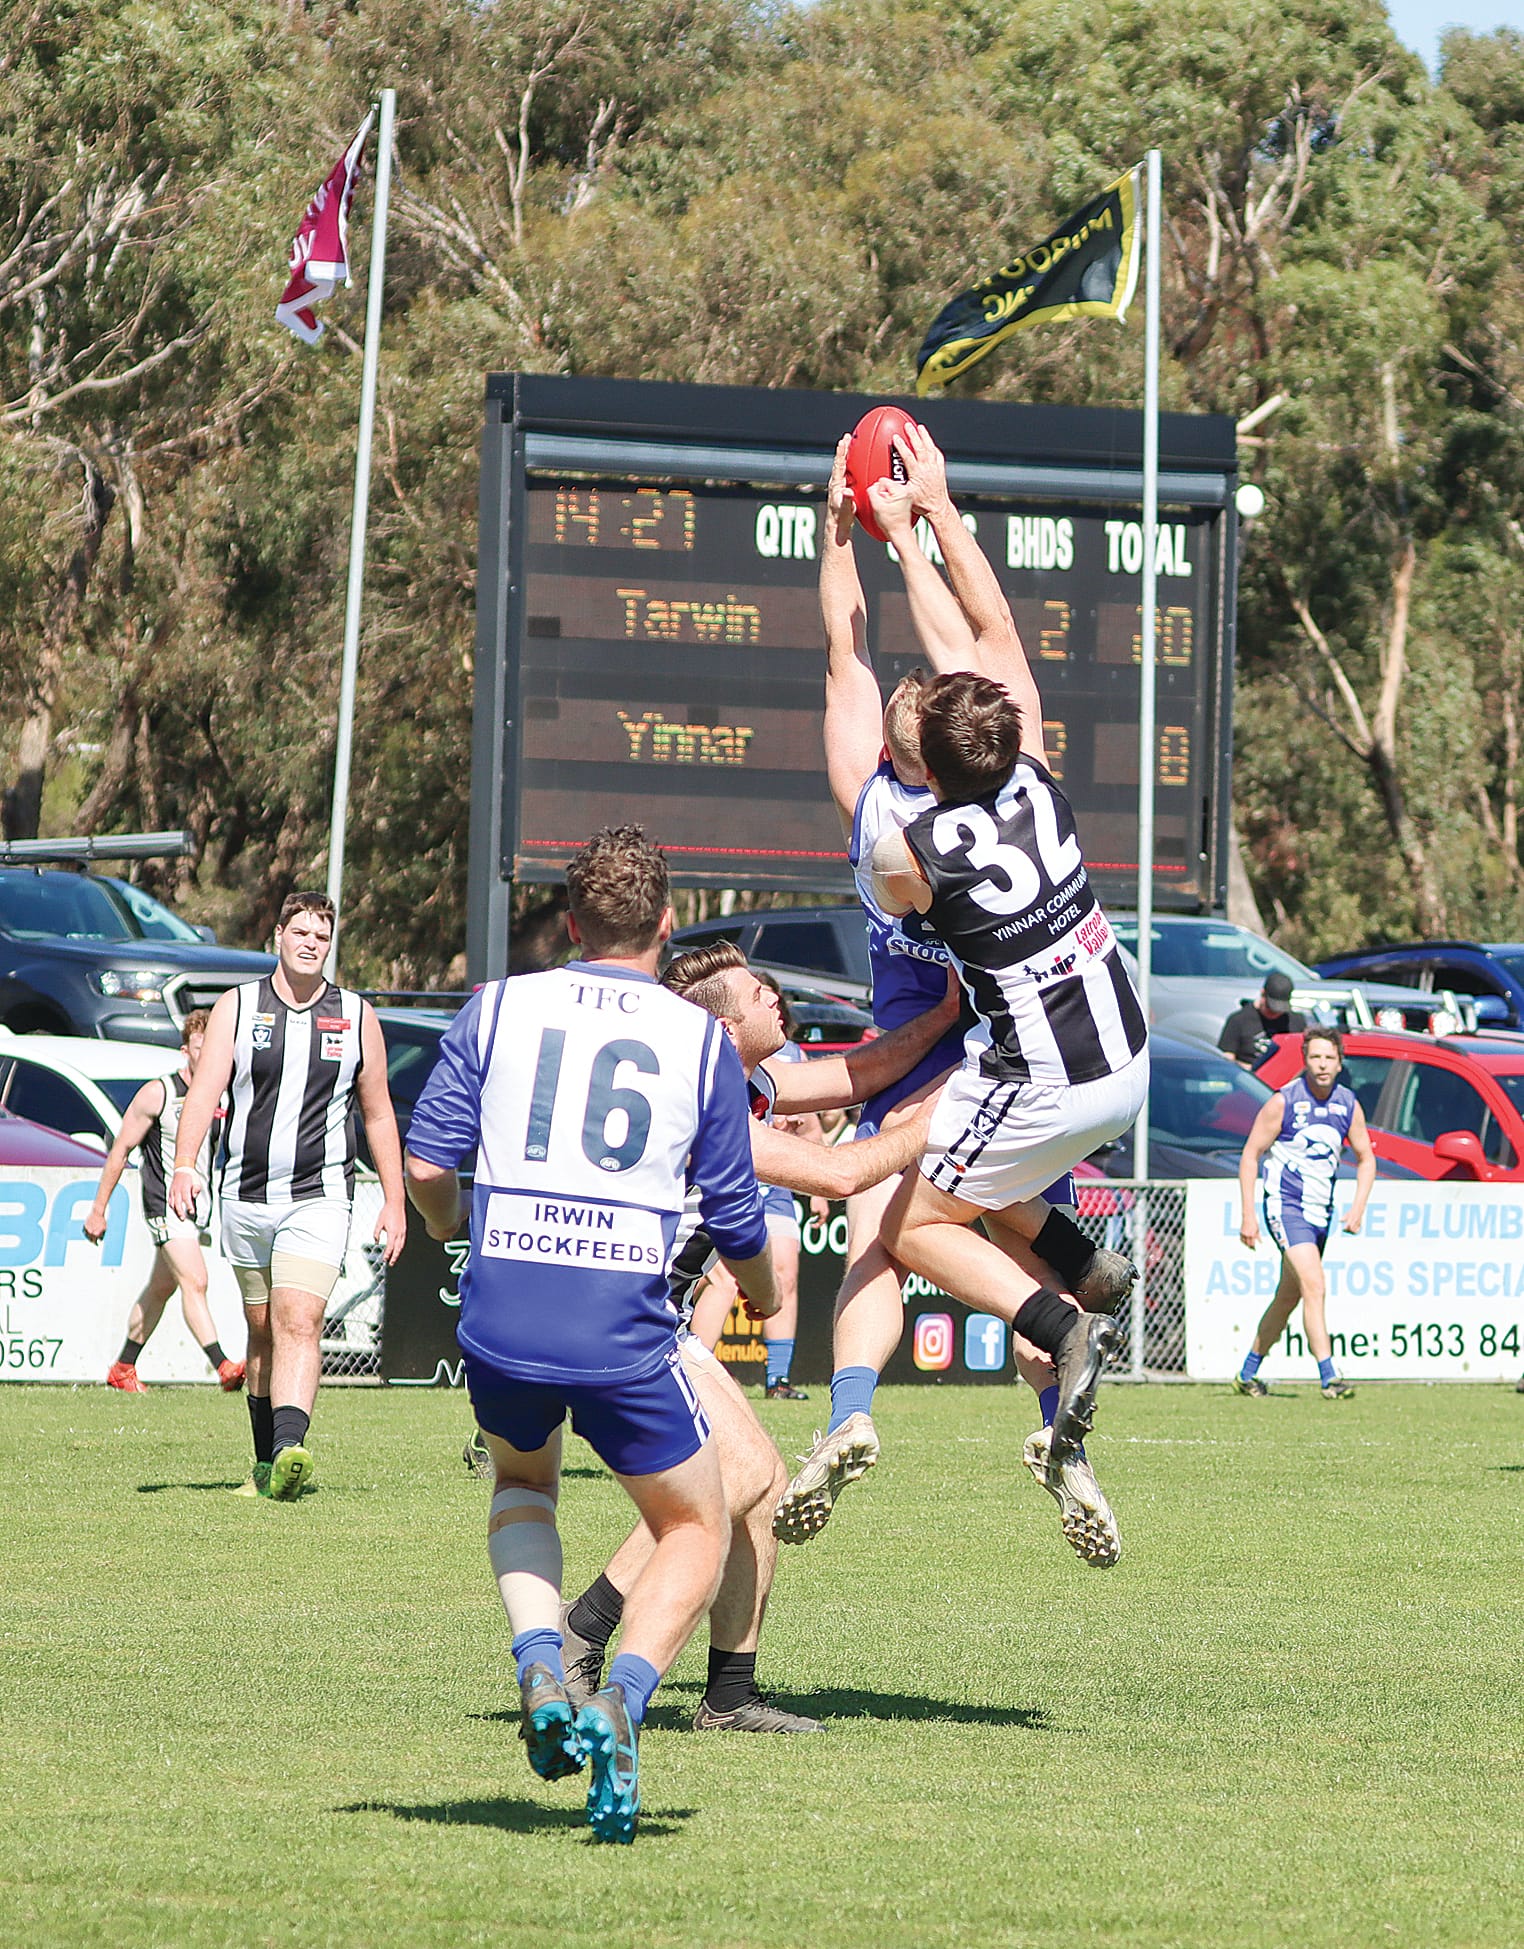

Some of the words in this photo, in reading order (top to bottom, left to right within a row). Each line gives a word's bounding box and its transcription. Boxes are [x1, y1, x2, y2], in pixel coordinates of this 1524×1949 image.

[756, 504, 817, 560] QTR
[1006, 515, 1075, 571] BHDS
[1104, 520, 1193, 577] TOAL
[616, 588, 761, 643] Tarwin
[1040, 600, 1070, 661] 2
[1159, 726, 1190, 786] 8
[932, 763, 1082, 915] 32
[992, 907, 1048, 942] YINNAR
[1047, 903, 1082, 935] HOTEL
[570, 983, 641, 1014] TFC
[524, 1027, 661, 1173] 16
[534, 1203, 615, 1230] IRWIN
[1398, 1203, 1524, 1239] PLUMB
[488, 1230, 660, 1264] STOCKFEEDS
[1205, 1260, 1395, 1297] ASBTOS
[0, 1304, 23, 1335] L
[0, 1339, 64, 1369] 567
[1264, 1323, 1379, 1358] hne:
[1391, 1323, 1465, 1357] 5133
